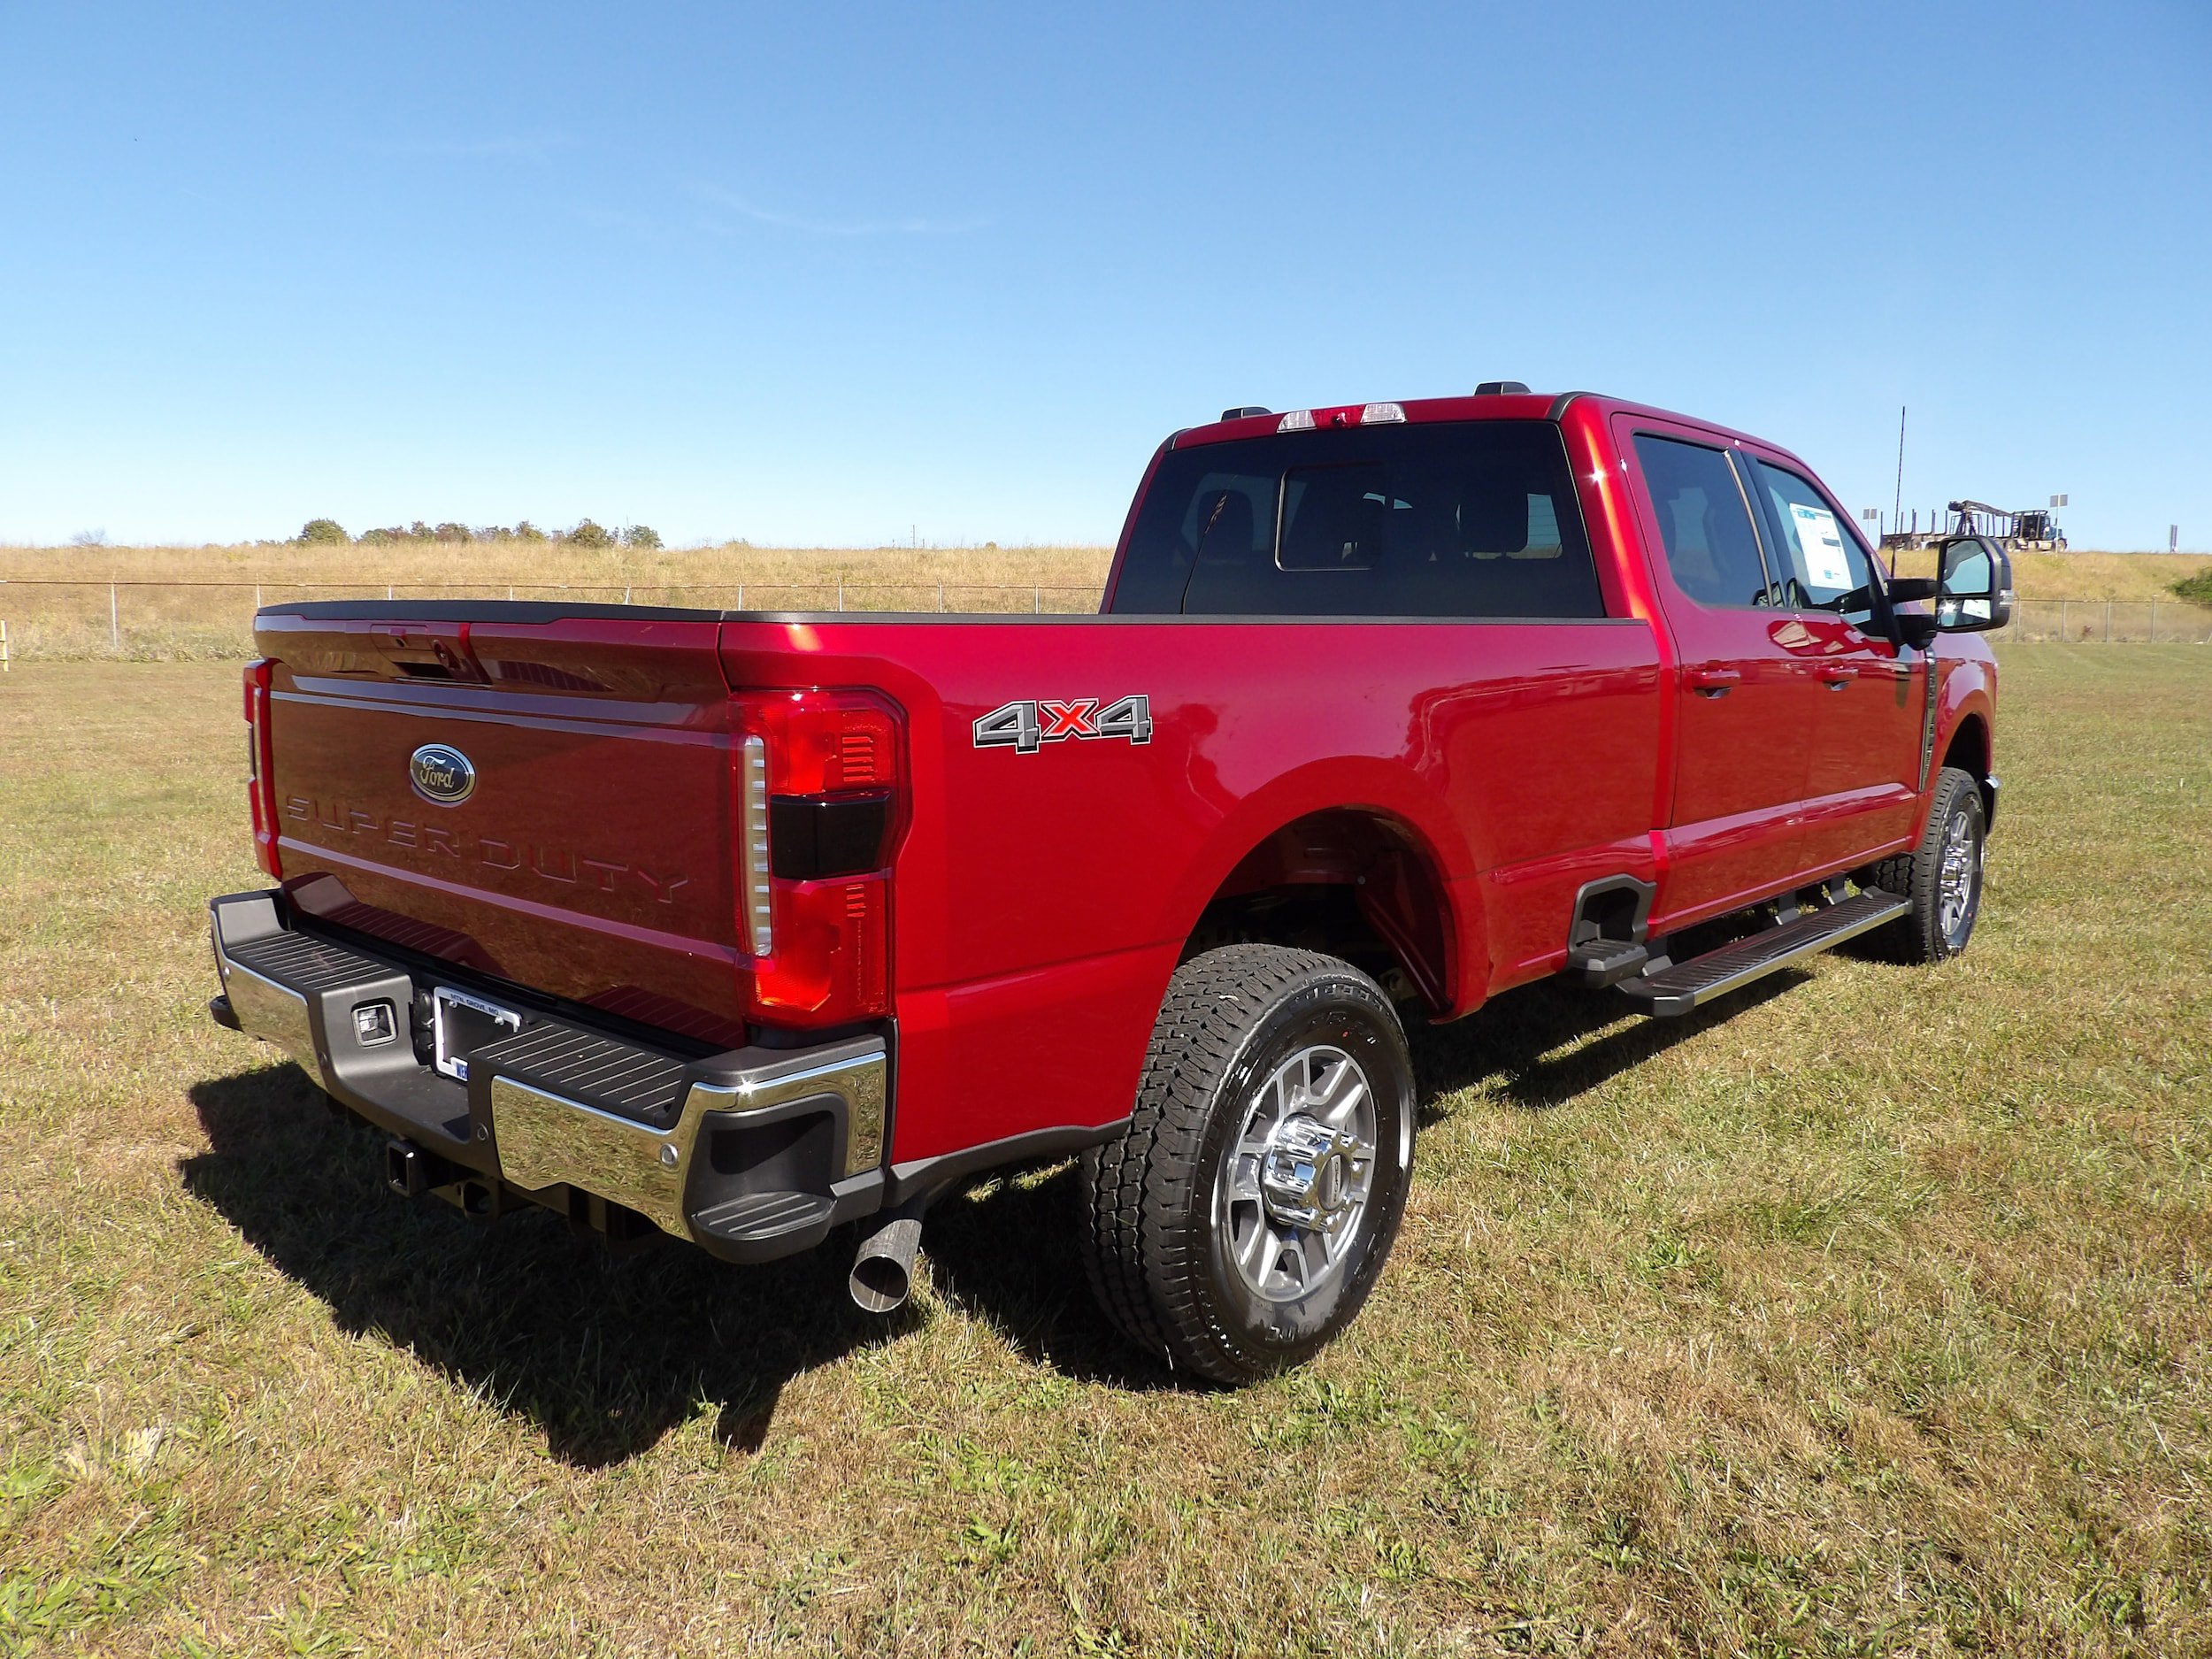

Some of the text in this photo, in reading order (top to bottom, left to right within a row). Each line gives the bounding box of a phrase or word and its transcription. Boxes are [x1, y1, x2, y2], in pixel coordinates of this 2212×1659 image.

[419, 754, 456, 789] Ford
[286, 795, 689, 904] SUPER DUTY
